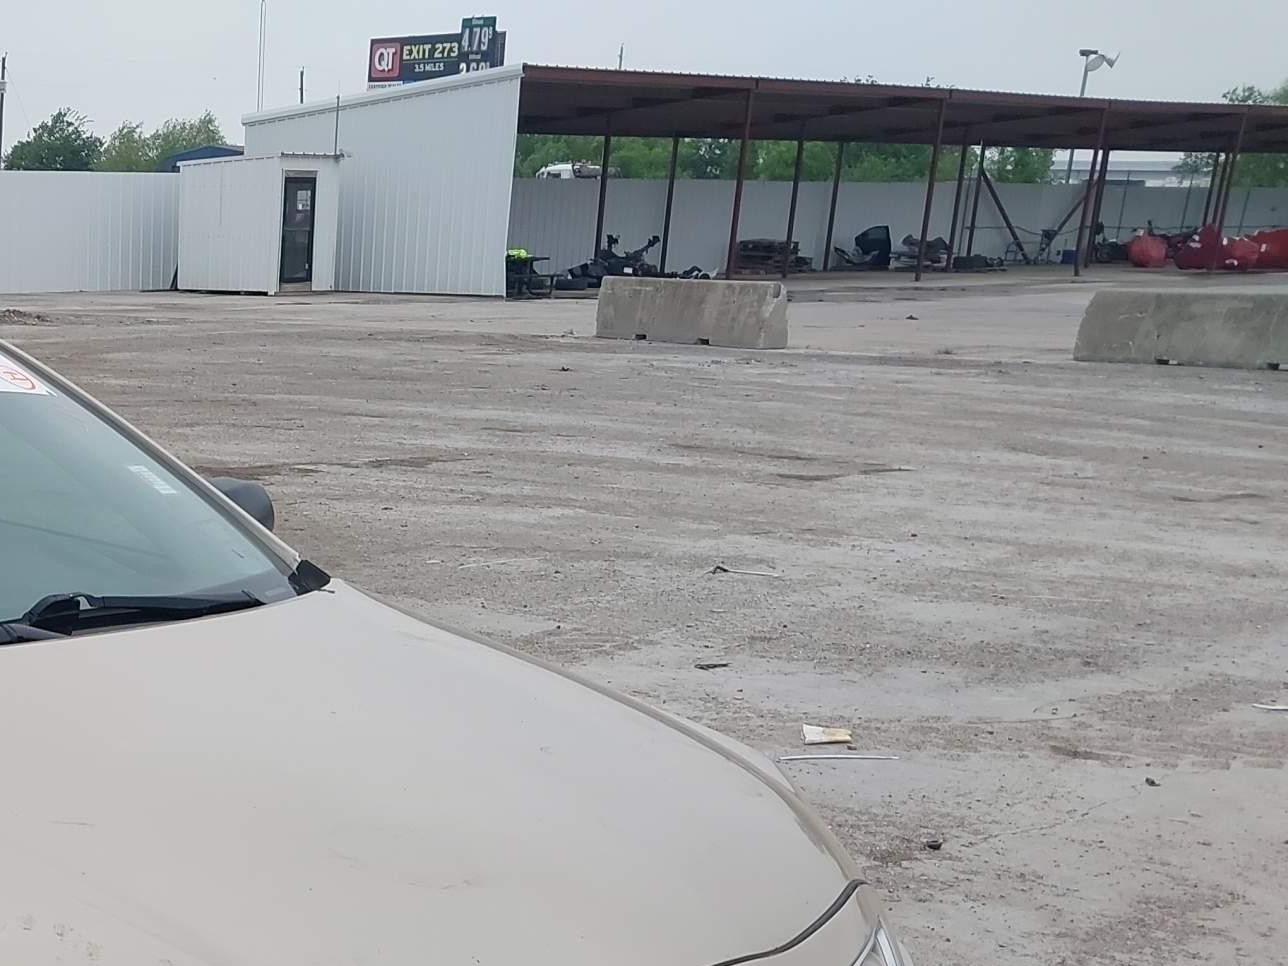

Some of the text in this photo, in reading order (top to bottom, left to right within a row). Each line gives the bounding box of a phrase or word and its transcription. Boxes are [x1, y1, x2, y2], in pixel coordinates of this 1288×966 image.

[374, 47, 396, 72] QT
[402, 42, 459, 60] EXIT 273
[425, 62, 444, 71] MILES
